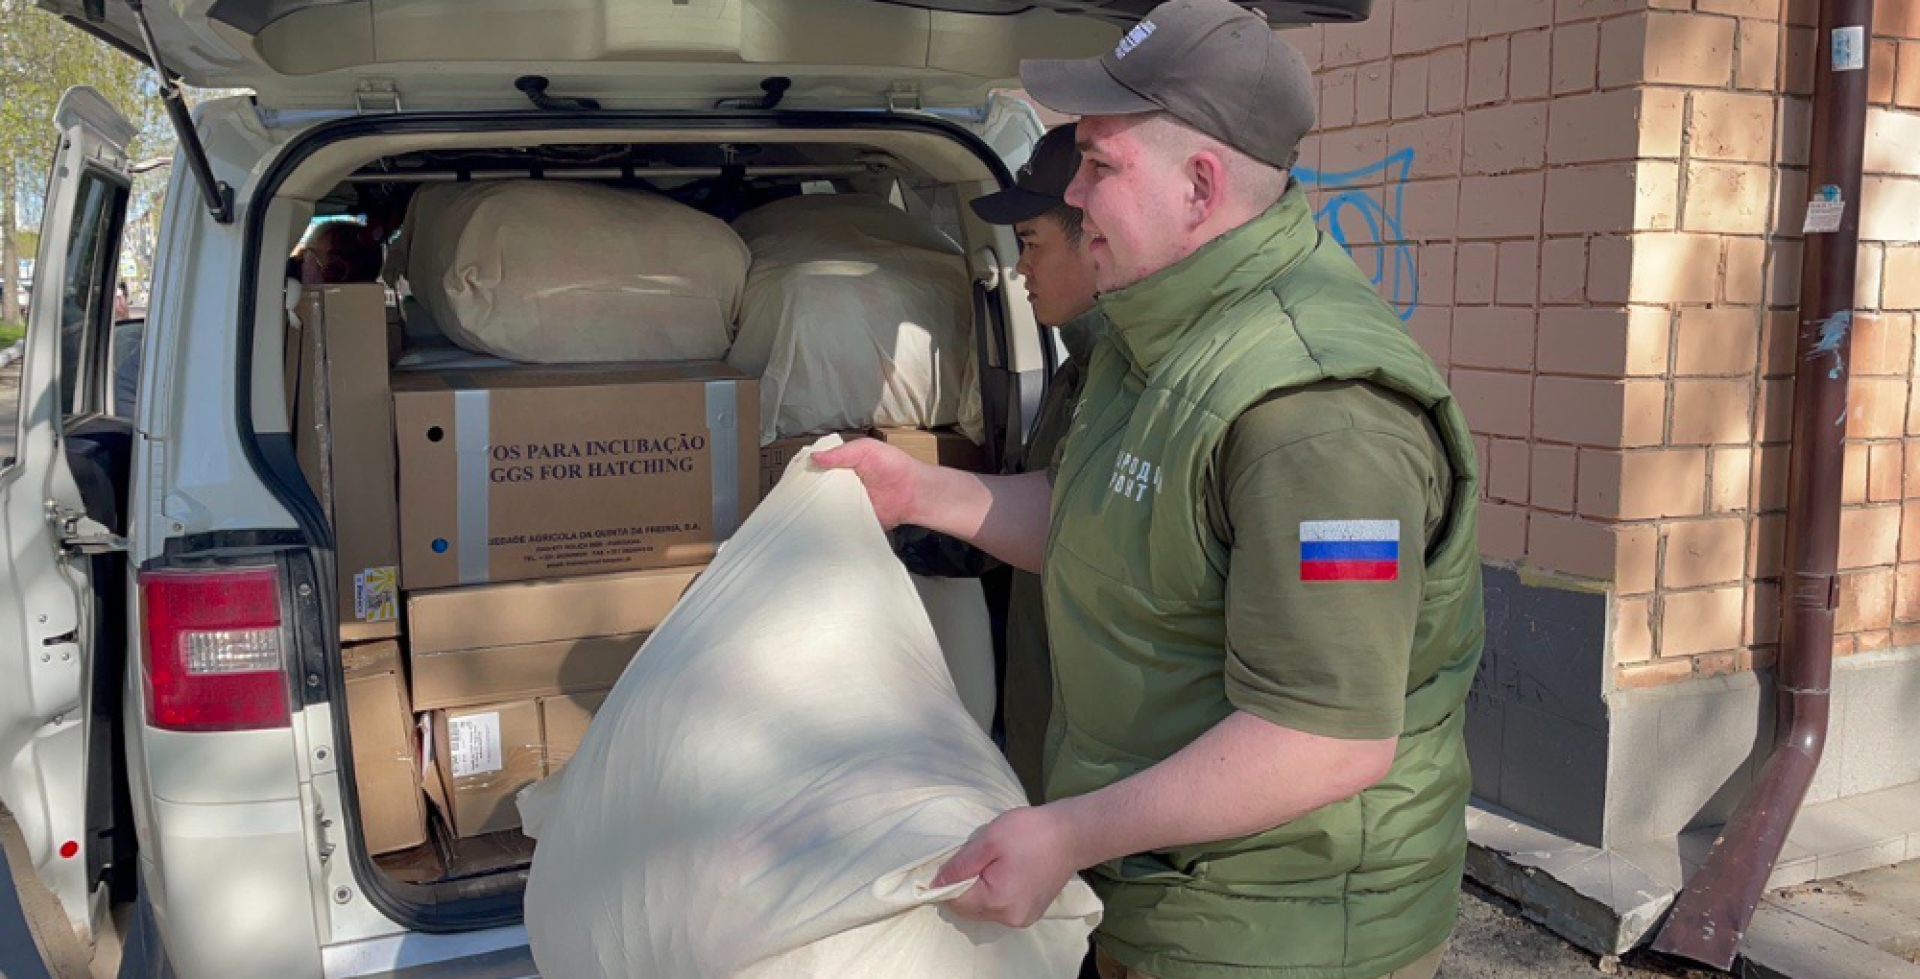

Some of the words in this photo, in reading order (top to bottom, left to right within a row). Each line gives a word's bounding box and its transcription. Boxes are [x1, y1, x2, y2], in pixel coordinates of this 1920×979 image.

[490, 444, 521, 461] OS
[526, 442, 582, 460] PARA
[585, 433, 706, 456] INCUBAÇÃO
[489, 465, 534, 482] GGS
[540, 463, 582, 480] FOR
[587, 456, 694, 478] HATCHING
[579, 530, 592, 539] DA
[631, 526, 644, 535] DA
